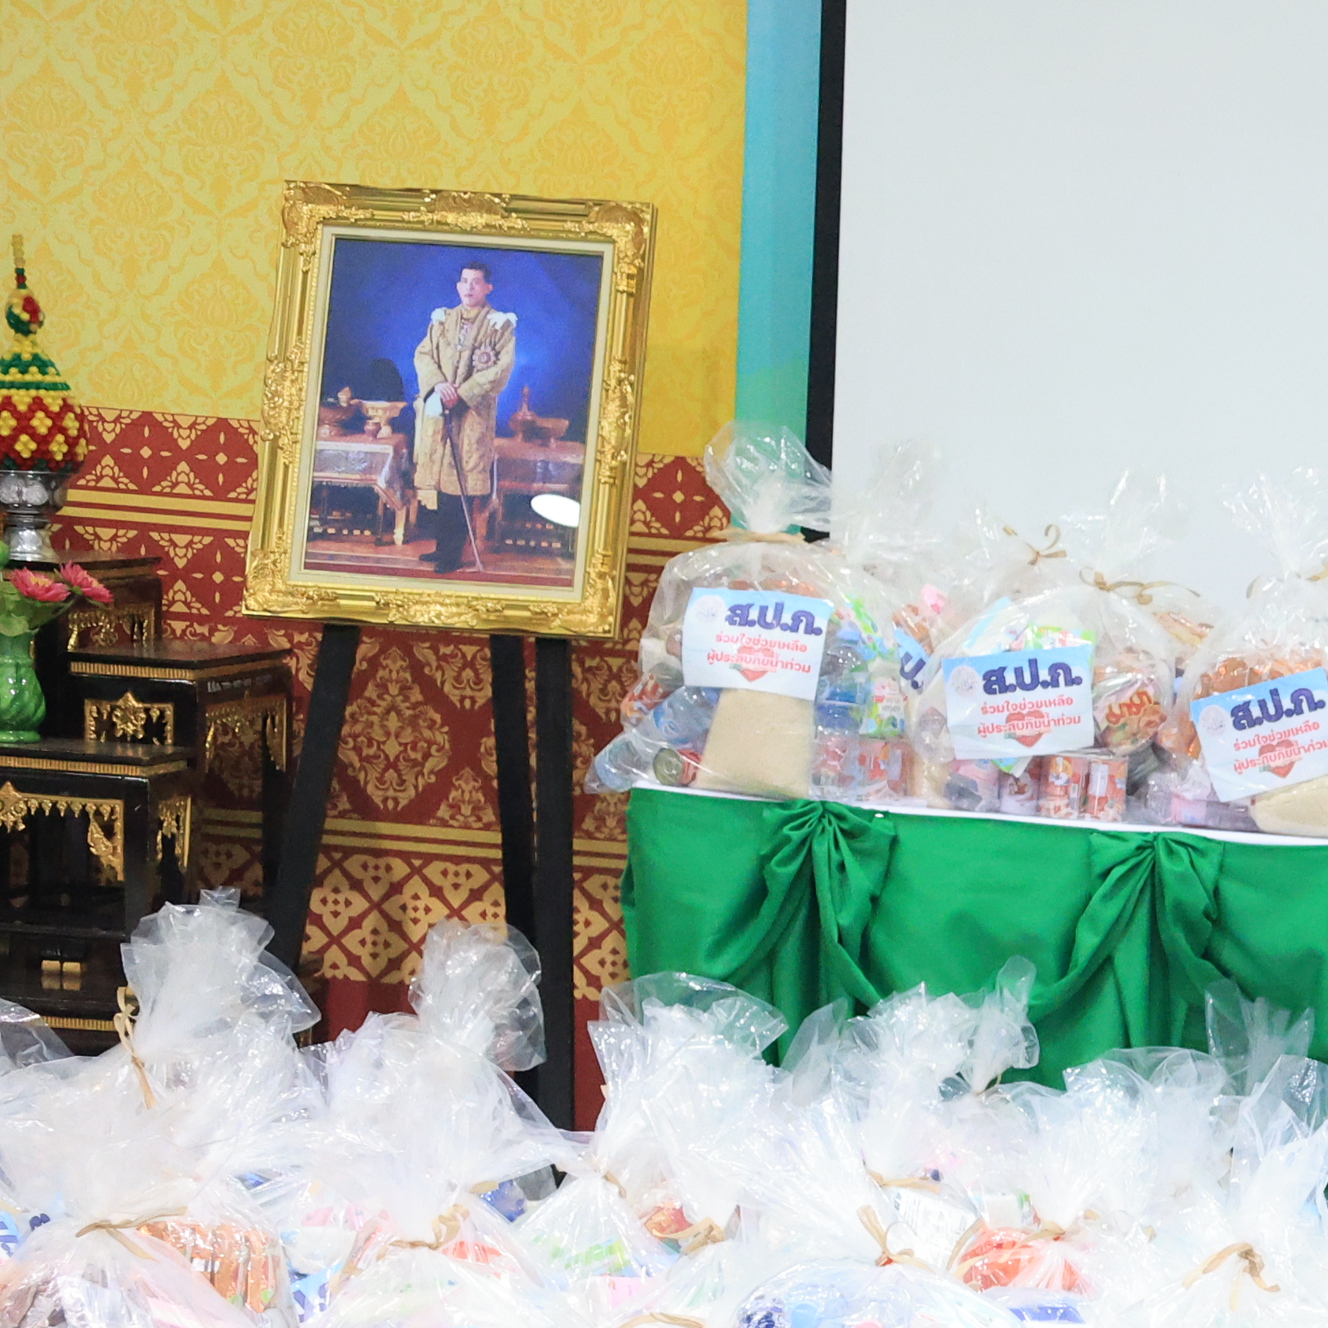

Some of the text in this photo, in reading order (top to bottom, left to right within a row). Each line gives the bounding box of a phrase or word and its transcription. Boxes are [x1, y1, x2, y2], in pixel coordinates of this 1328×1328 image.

[725, 601, 823, 636] ส.ป.ก.
[714, 632, 808, 654] ร่วมใจช่วยเหลือ
[707, 650, 811, 674] ผู้ประสบภัยน้ำท่วม
[982, 658, 1082, 695] ส.ป.ก.
[981, 693, 1074, 715] ร่วมใจช่วยเหลือ
[1231, 688, 1326, 731] ส.ป.ก.
[978, 712, 1081, 737] ผู้ประสบภัยน้ำท่วม
[1234, 721, 1320, 751] ร่วมใจช่วยเหลือ
